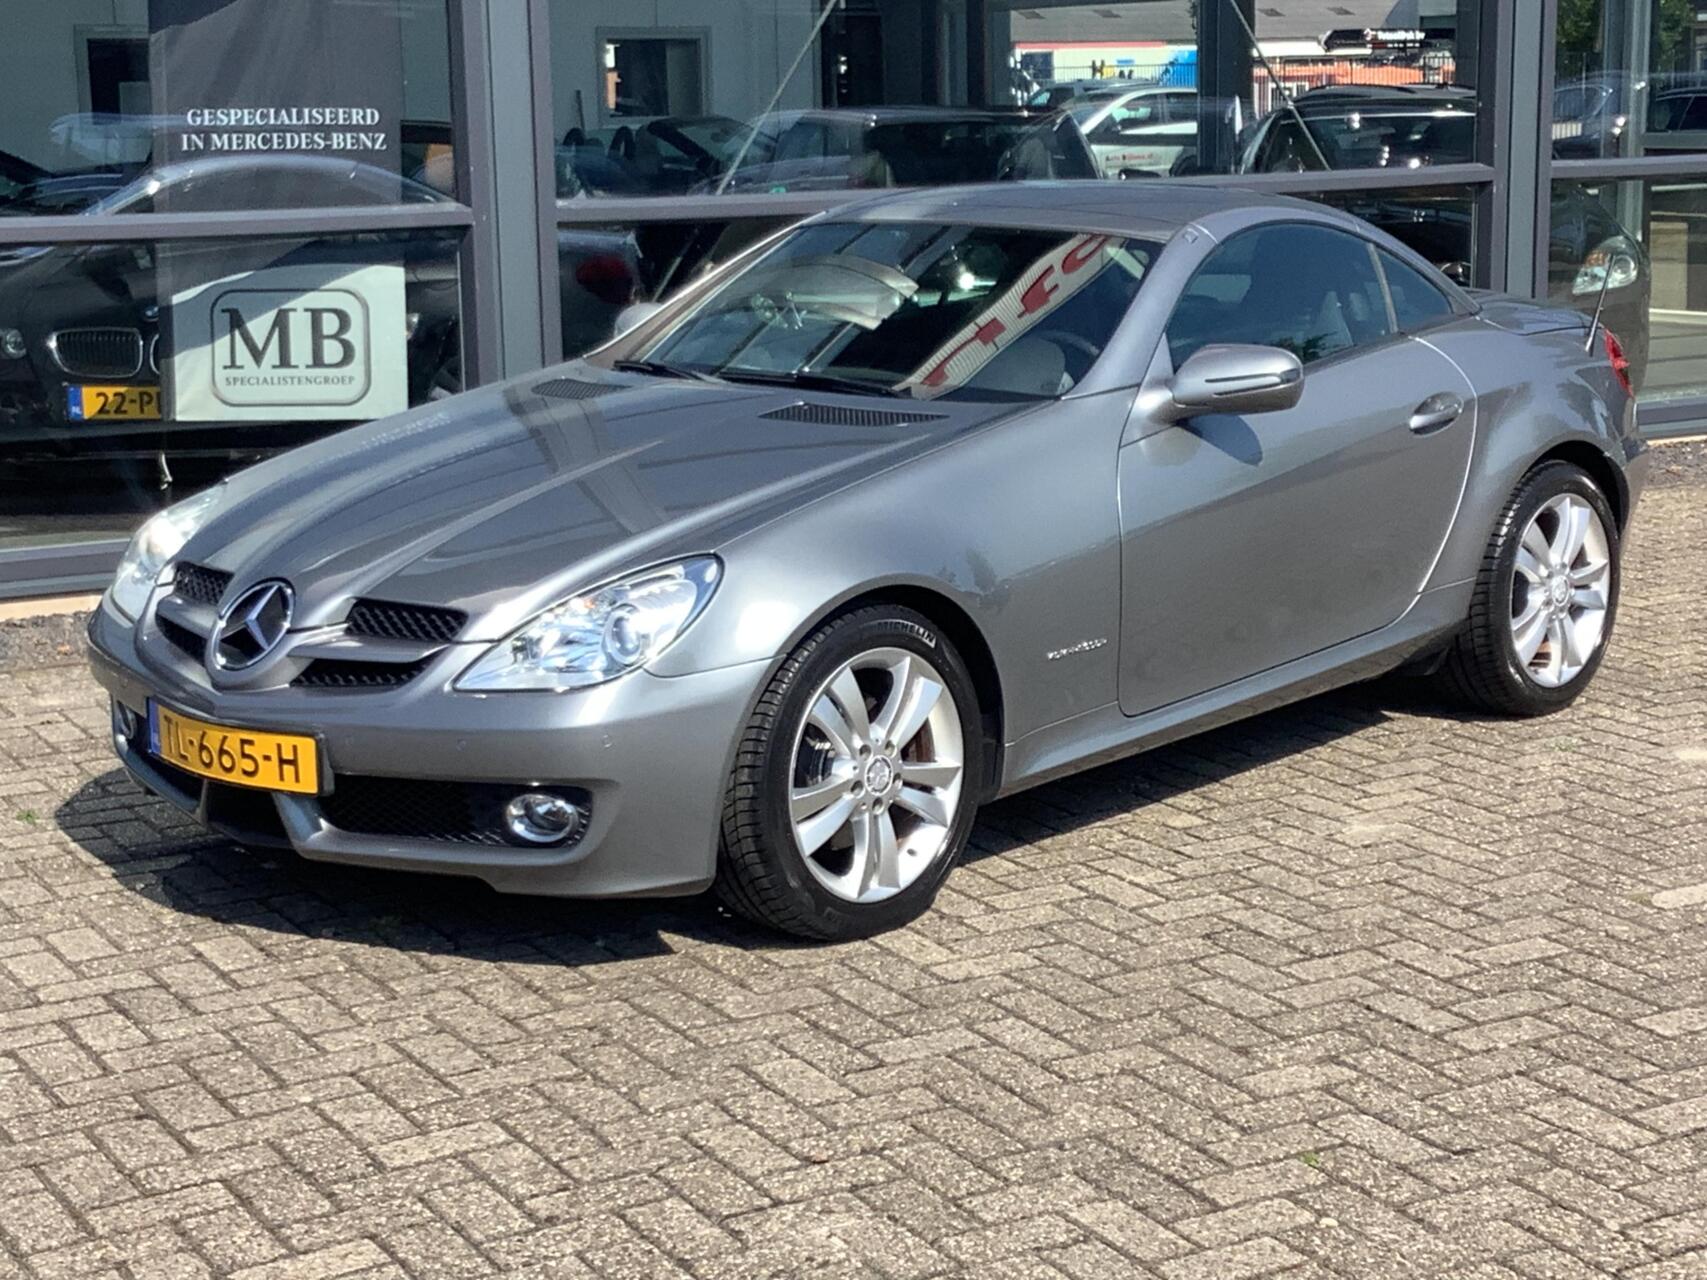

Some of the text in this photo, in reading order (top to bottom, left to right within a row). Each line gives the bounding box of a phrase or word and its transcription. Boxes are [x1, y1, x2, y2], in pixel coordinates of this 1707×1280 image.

[186, 107, 380, 127] GESPECIALISEERD
[181, 132, 387, 151] IN MERCEDES-BENZ
[220, 307, 356, 370] MB
[225, 375, 355, 387] SPECIALISTENGROEP
[163, 714, 300, 784] TL-665-H
